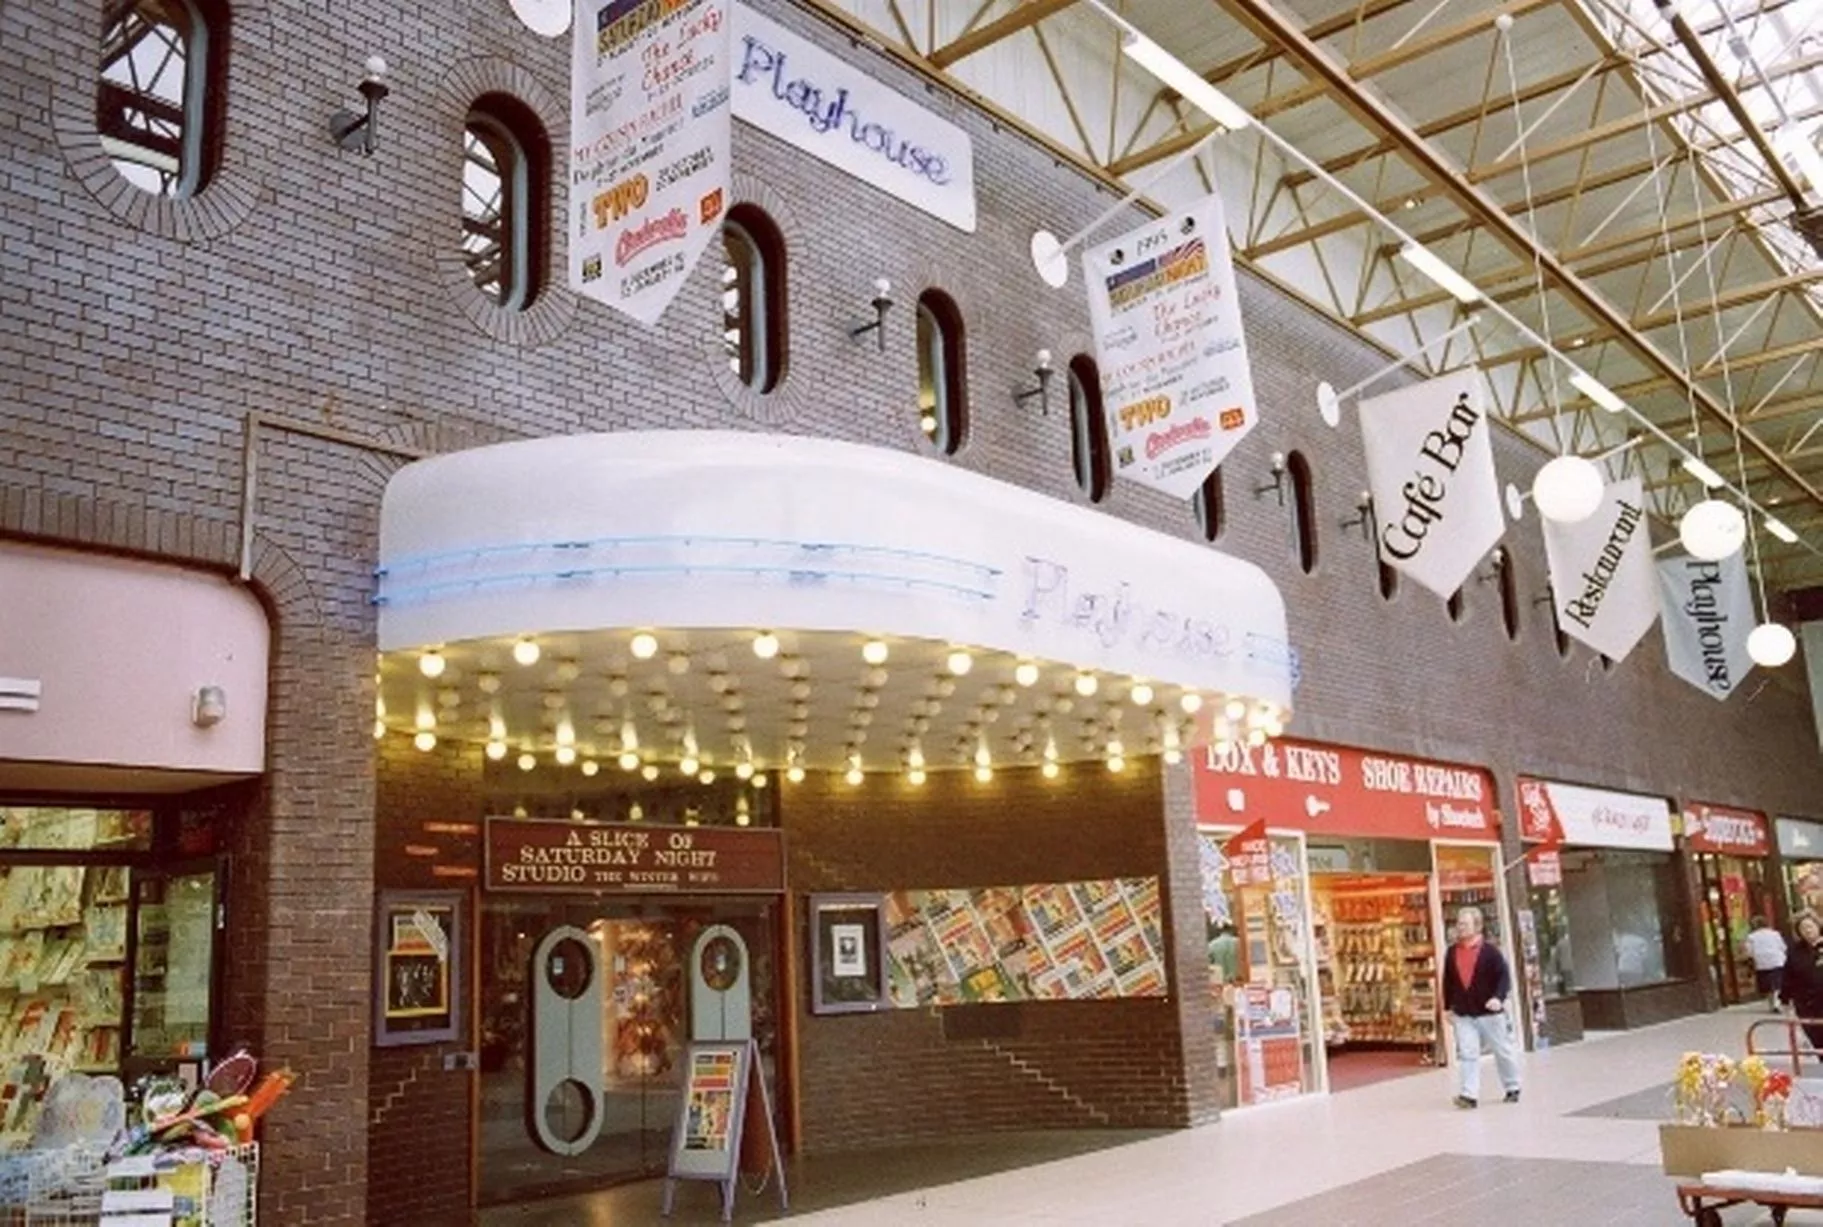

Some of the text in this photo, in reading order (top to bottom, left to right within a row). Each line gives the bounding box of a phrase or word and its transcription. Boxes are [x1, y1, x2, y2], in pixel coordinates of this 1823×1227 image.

[736, 34, 952, 186] Playhouse
[593, 172, 649, 229] TWO
[1119, 393, 1172, 432] TWO
[1382, 392, 1480, 560] Café Bar
[1564, 499, 1643, 629] Restaurant
[1686, 560, 1732, 690] Playhouse
[1284, 745, 1342, 785] KEYS
[1361, 756, 1412, 793] SHOE
[1414, 762, 1483, 801] REPAIRS
[520, 846, 718, 868] SATURDAY NIGHT
[565, 830, 694, 850] A SLICE OF
[502, 863, 587, 883] STUDIO
[594, 871, 623, 883] THE
